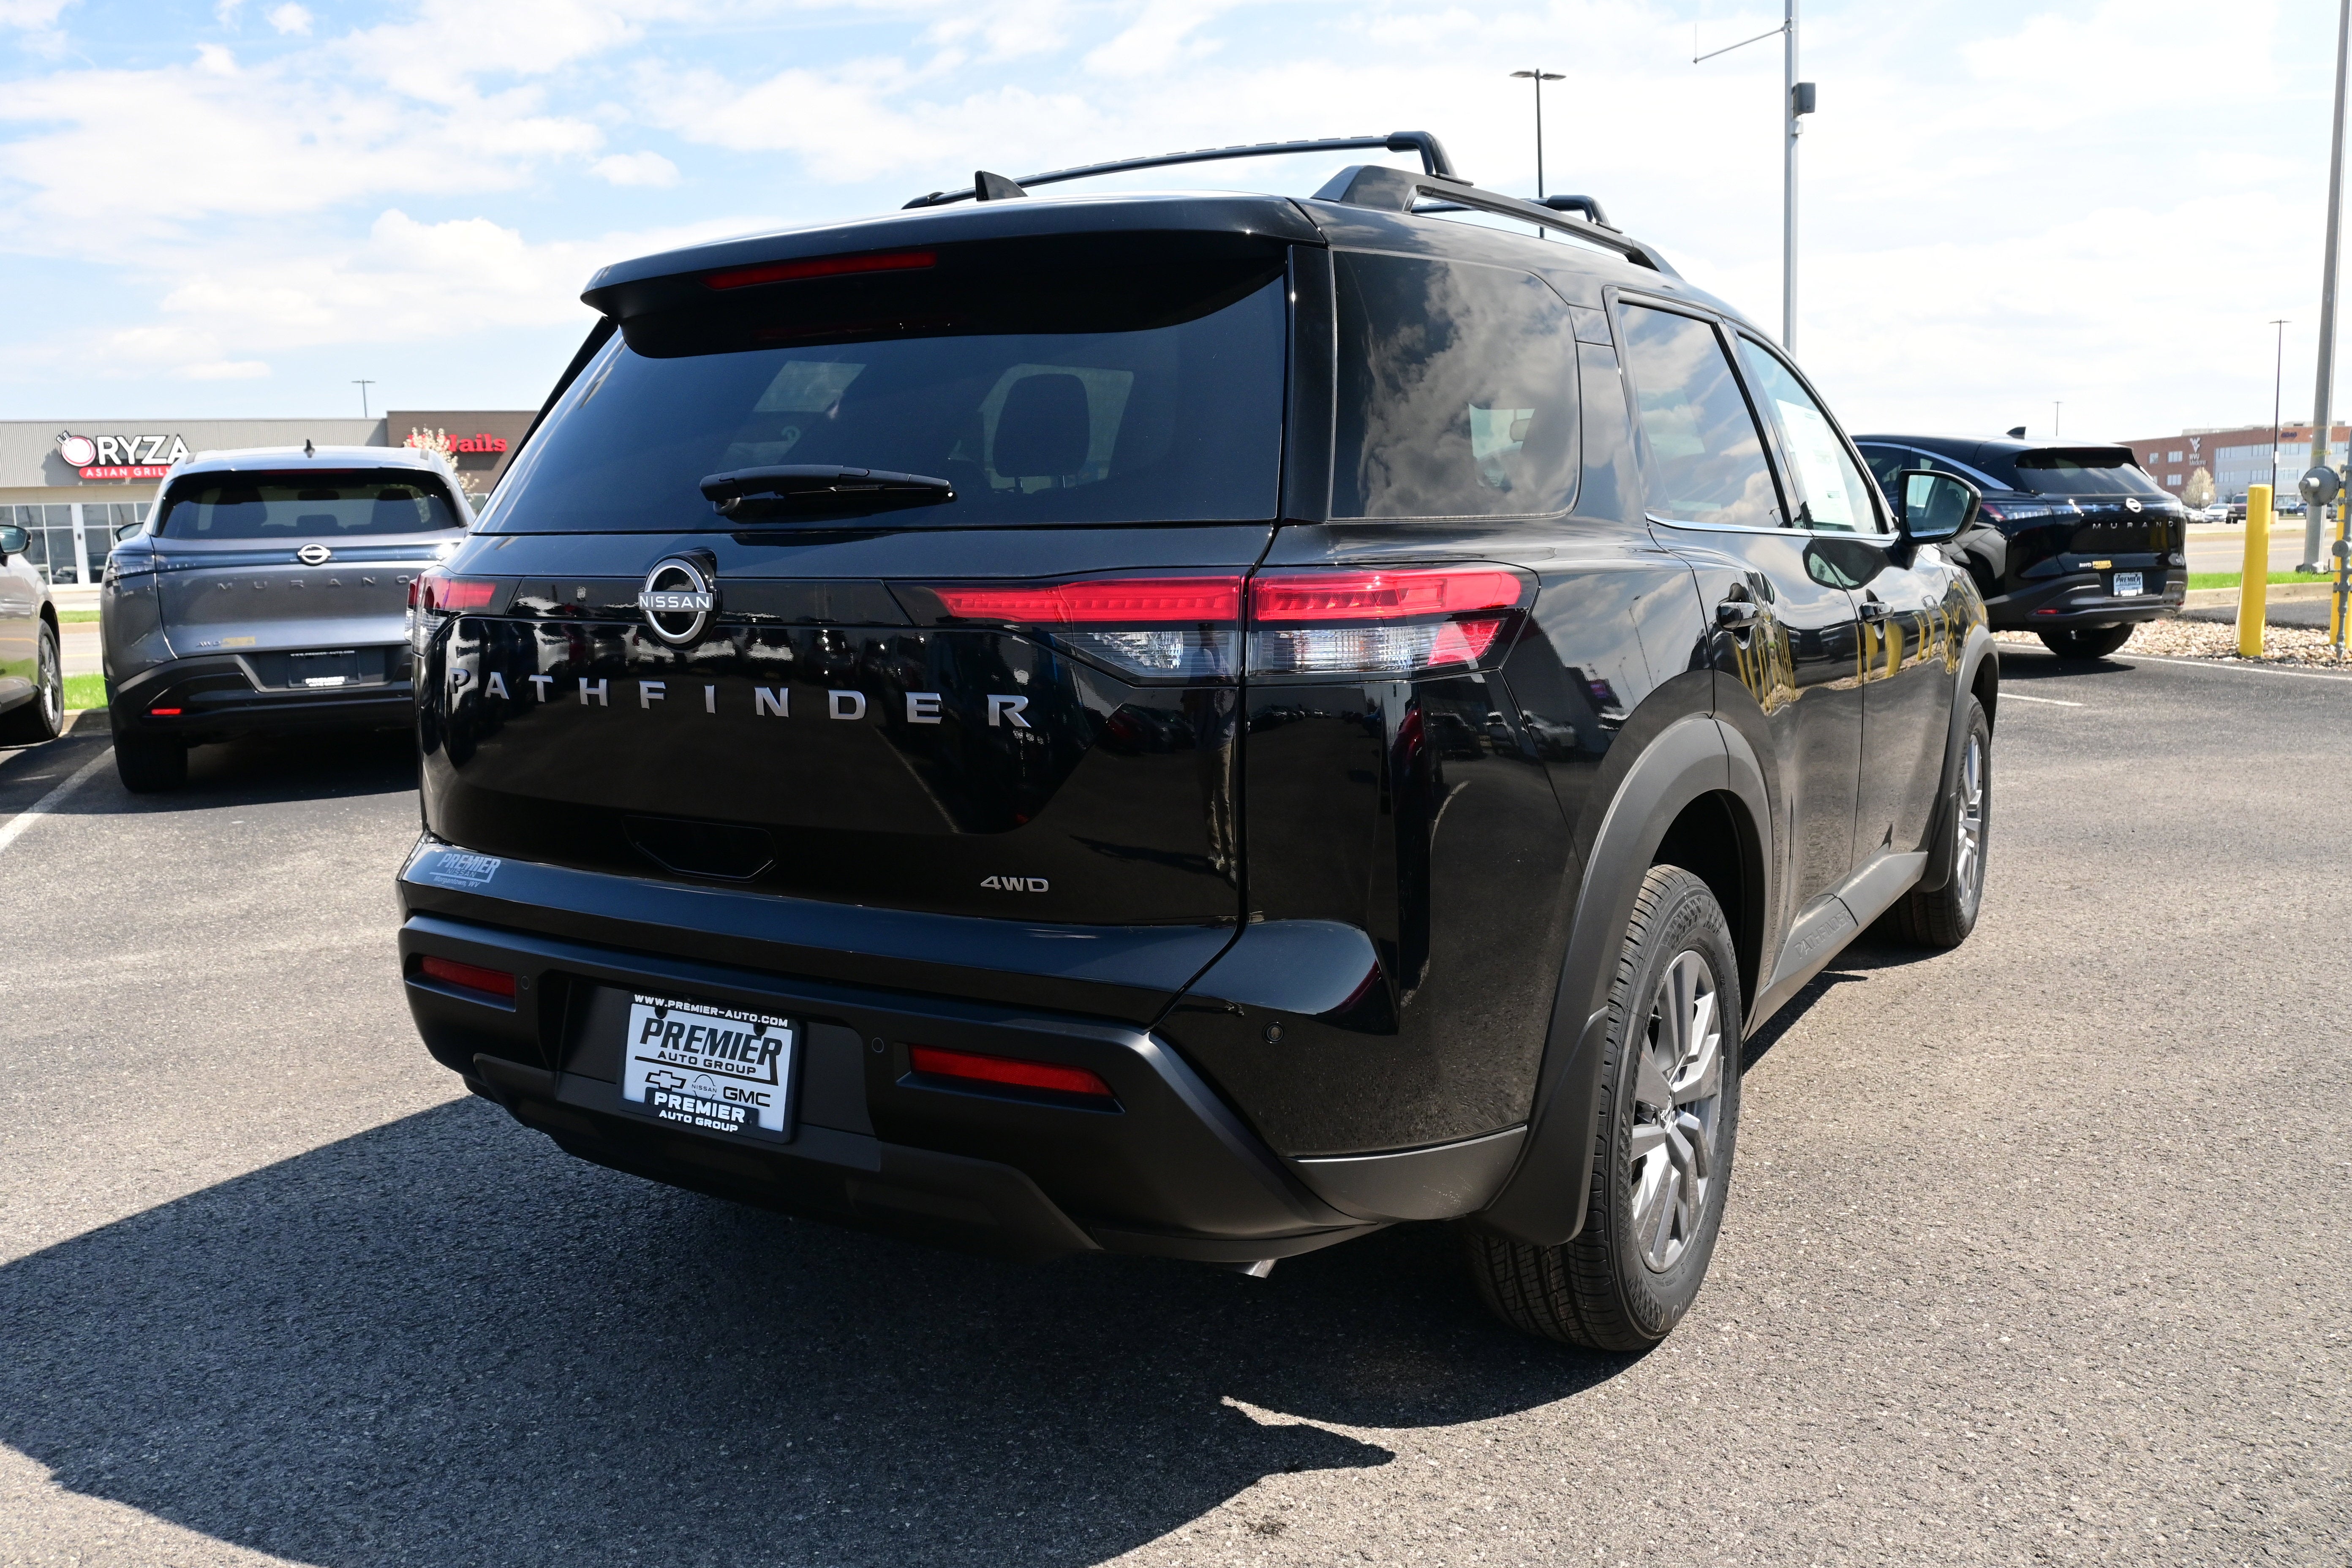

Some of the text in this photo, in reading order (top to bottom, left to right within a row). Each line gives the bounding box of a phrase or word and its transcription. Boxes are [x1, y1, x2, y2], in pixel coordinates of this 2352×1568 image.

[86, 468, 127, 477] ASIAN
[2092, 521, 2174, 529] MURANO
[217, 574, 409, 591] MURANO
[639, 596, 710, 608] NISSAN
[448, 667, 1032, 728] PATHFINDER
[437, 853, 501, 874] PREMIER
[446, 868, 477, 877] NISSAN
[433, 875, 467, 887] Morgantown,
[980, 876, 1049, 892] 4WD
[1793, 909, 1852, 960] PATHFINDER
[634, 994, 788, 1028] WWW.PREMIER-AUTO.COM
[640, 1017, 783, 1069] PREMIER
[657, 1051, 757, 1075] AUTO GROUP
[691, 1083, 771, 1108] NISSAN GMC
[654, 1091, 746, 1123] PREMIER
[659, 1109, 739, 1132] AUTO GROUP
